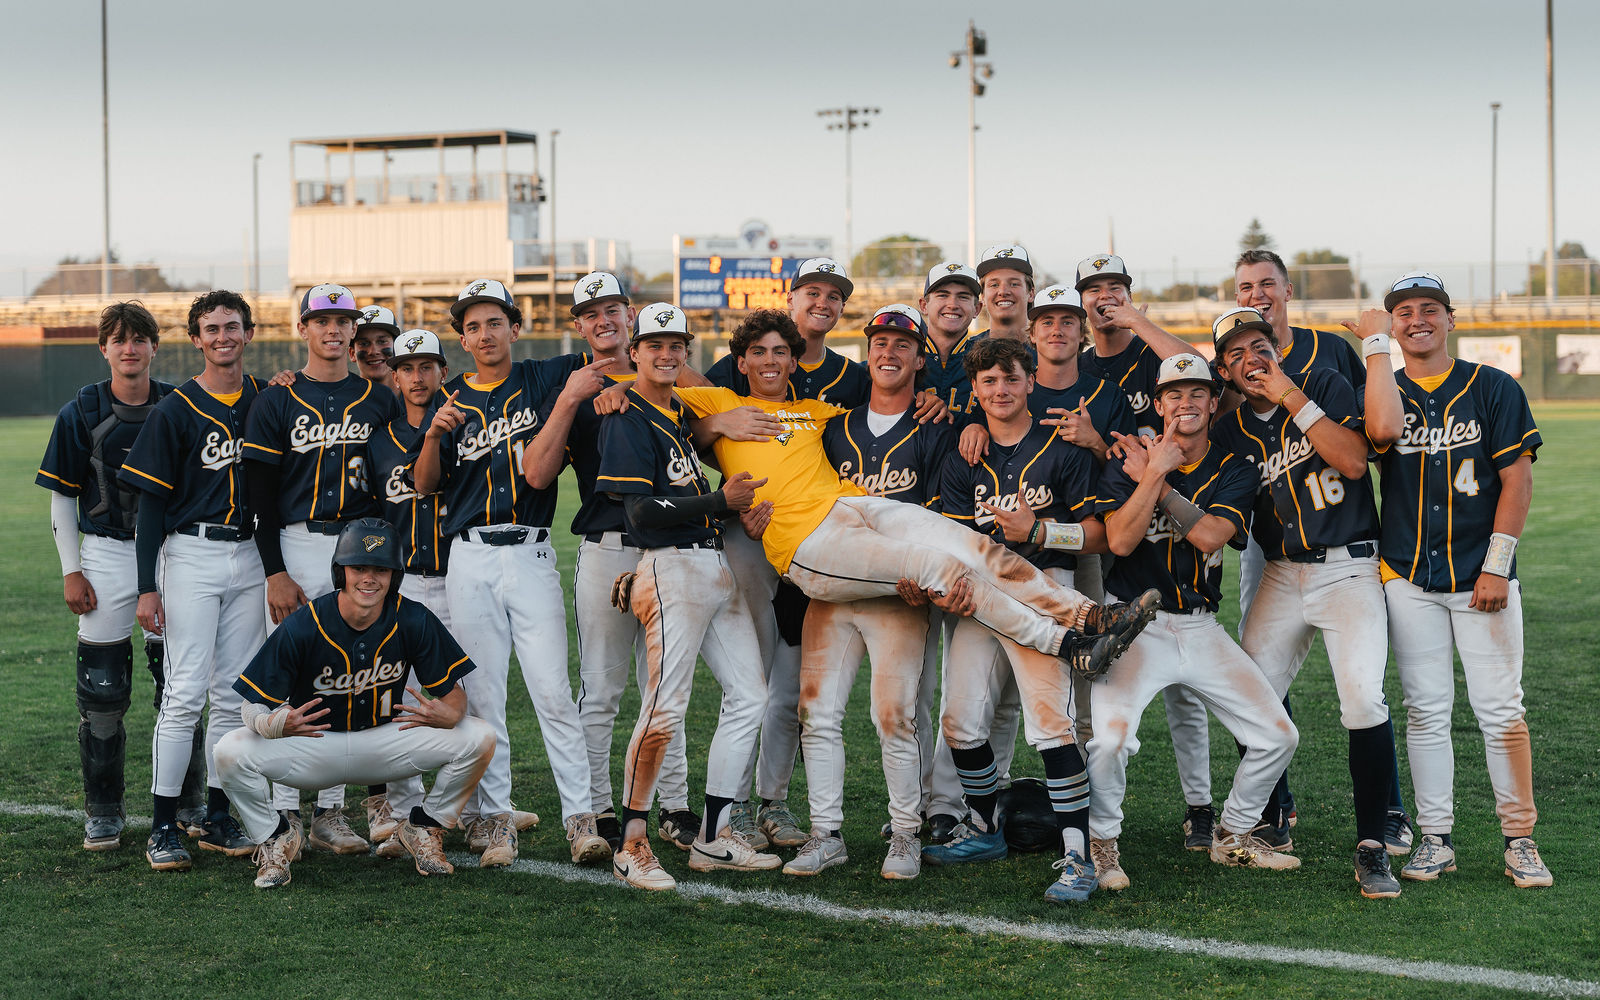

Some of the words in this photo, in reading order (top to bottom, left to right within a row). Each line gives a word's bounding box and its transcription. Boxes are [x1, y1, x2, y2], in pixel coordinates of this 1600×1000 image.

[291, 414, 373, 452] Eagles
[782, 422, 818, 431] BALL
[1394, 413, 1482, 455] Eagles
[201, 431, 244, 470] Eag
[512, 439, 527, 476] 1
[1245, 436, 1317, 483] agles
[1304, 466, 1345, 511] 16
[1453, 458, 1480, 496] 4
[313, 656, 406, 695] Eagles
[380, 689, 392, 718] 1
